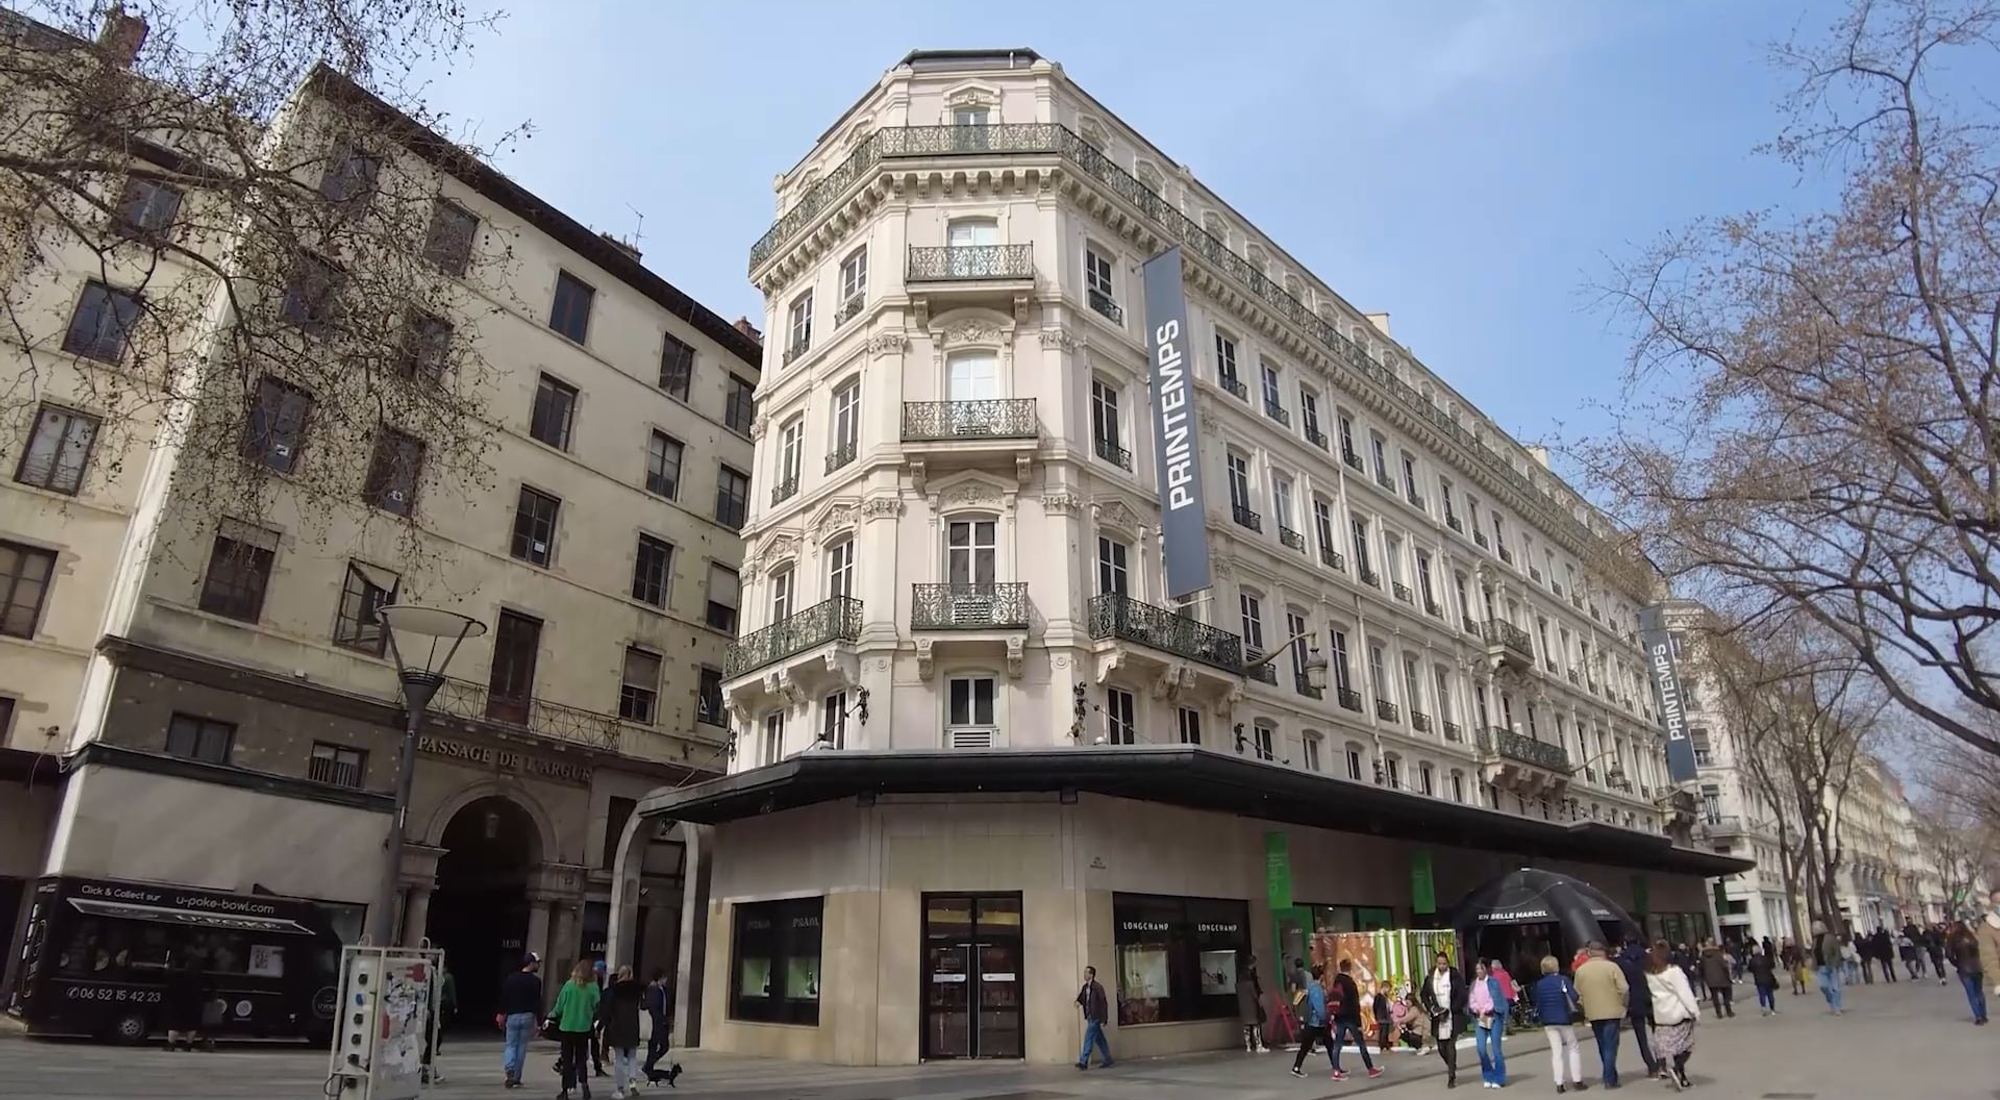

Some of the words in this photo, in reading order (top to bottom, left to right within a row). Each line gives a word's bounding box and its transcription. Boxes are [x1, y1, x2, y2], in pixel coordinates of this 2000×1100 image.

[1156, 318, 1194, 511] PRINTEMPS
[1653, 643, 1686, 741] PRINTEMPS
[417, 735, 491, 763] PASSAGE
[499, 751, 519, 768] DE
[81, 885, 104, 895] Click
[104, 888, 112, 896] &
[113, 888, 145, 900] Collect
[146, 893, 161, 901] sur
[175, 896, 275, 914] u-poke-bowl.com
[1515, 910, 1548, 919] MARCEL
[1122, 921, 1169, 931] LONGCHAMP
[1197, 923, 1238, 932] LONGCHAMP
[80, 987, 95, 999] 06
[97, 988, 113, 1001] 52
[115, 989, 127, 1001] 15
[129, 991, 145, 1002] 42
[146, 991, 161, 1002] 23
